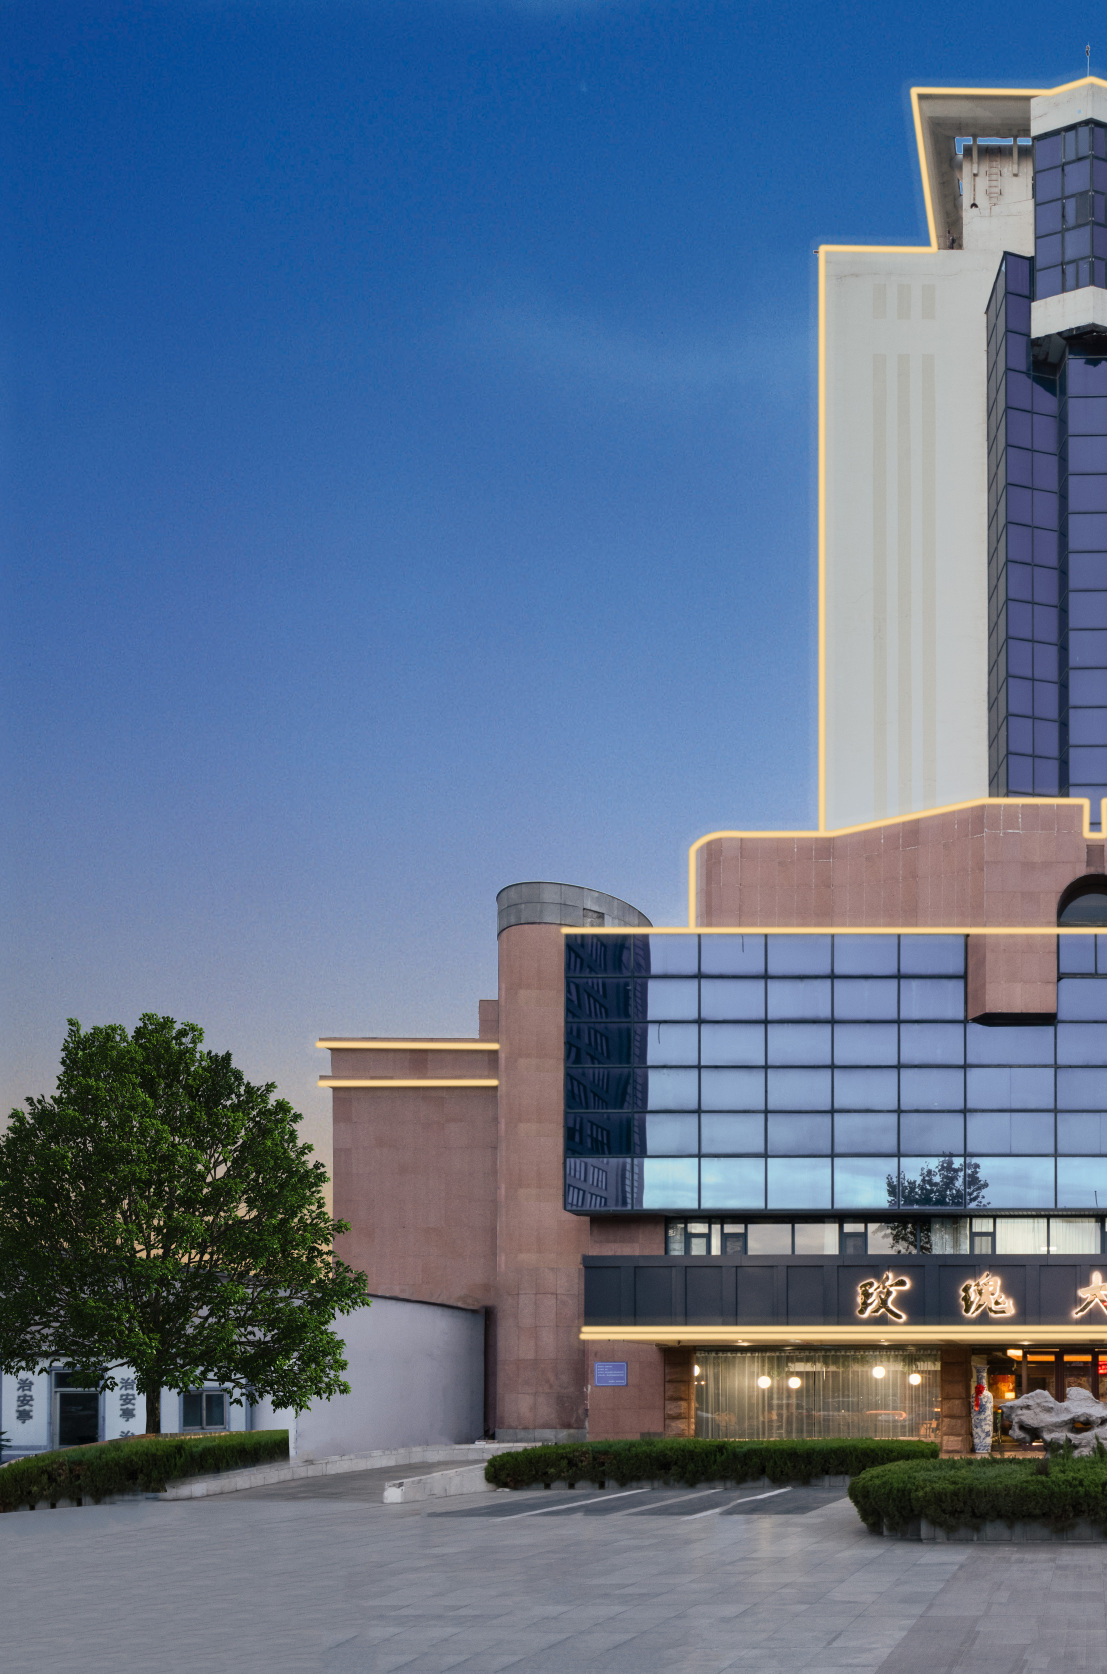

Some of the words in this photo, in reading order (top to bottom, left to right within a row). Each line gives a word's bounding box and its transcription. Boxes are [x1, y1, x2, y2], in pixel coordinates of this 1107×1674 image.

[16, 1378, 34, 1424] 治安亭
[119, 1377, 136, 1422] 治安亭
